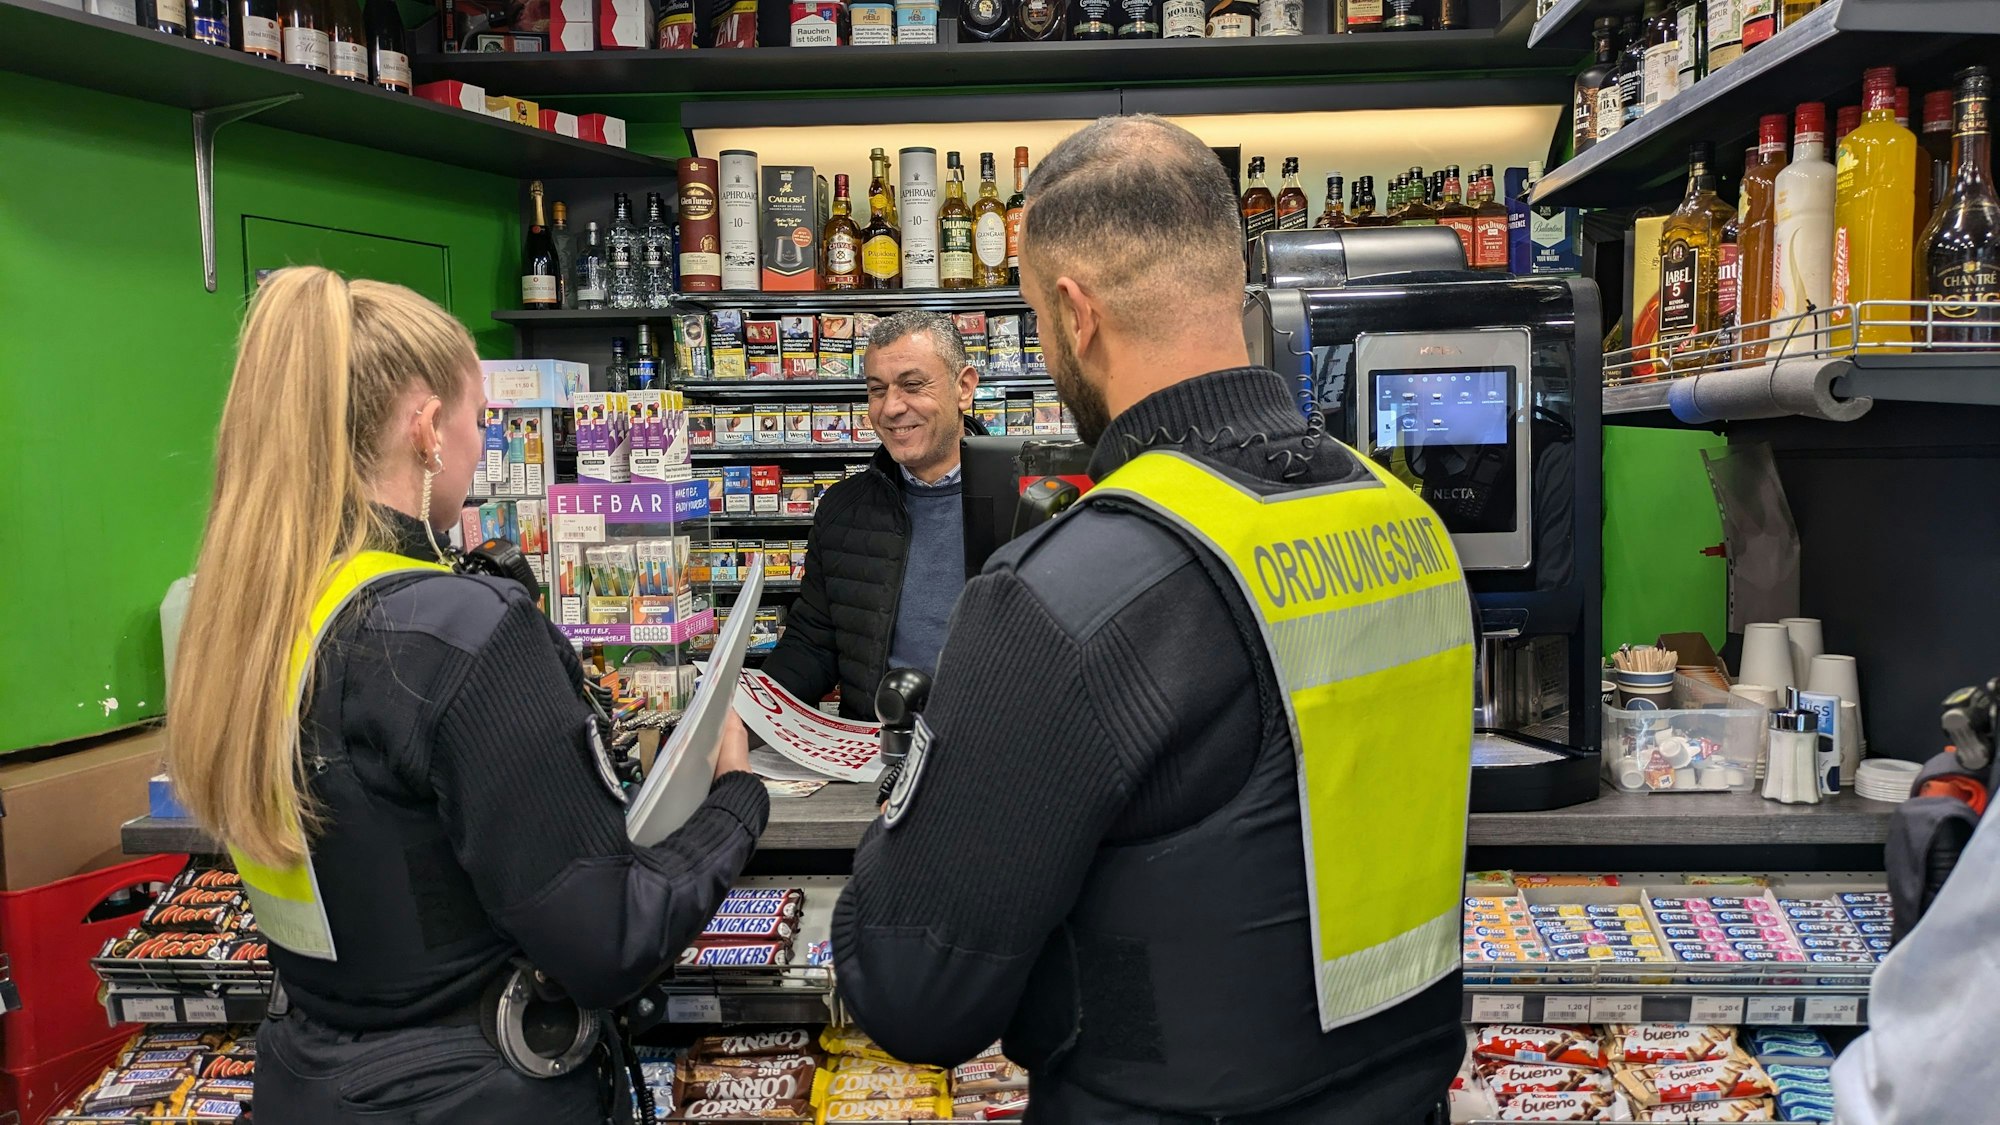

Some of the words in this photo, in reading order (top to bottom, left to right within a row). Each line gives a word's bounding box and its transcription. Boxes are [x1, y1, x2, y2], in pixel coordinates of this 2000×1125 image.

[797, 28, 830, 36] Rauchen
[806, 34, 832, 43] tödlich
[734, 217, 743, 228] 10
[912, 215, 922, 226] 10
[1477, 221, 1490, 234] JACK
[951, 229, 967, 237] DEW
[1665, 267, 1692, 287] LABEL
[1832, 226, 1848, 319] Berentzen
[1943, 270, 1997, 288] CHANTRÉ
[1671, 282, 1681, 297] 5
[1929, 292, 2000, 318] ROUG
[693, 431, 713, 445] ducal
[1433, 487, 1475, 500] NECTA
[557, 494, 662, 514] ELFBAR
[1253, 517, 1450, 609] ORDNUNGSAMT
[773, 730, 863, 770] Keine
[193, 869, 241, 887] Mar
[172, 887, 240, 905] Mars
[728, 889, 785, 899] NICKERS
[152, 904, 223, 925] Mars
[717, 900, 782, 914] NICKERS
[705, 917, 776, 933] SNICKERS
[1607, 933, 1628, 942] xtra
[126, 938, 216, 960] Mars
[231, 942, 268, 961] Ma
[700, 946, 772, 965] SNICKERS
[1500, 1003, 1515, 1011] 1,20
[1567, 1003, 1582, 1011] 1,20
[1617, 1003, 1631, 1011] 1,20
[1718, 1004, 1734, 1012] 1,20
[1770, 1004, 1786, 1012] 1,20
[1833, 1004, 1848, 1012] 1,20
[1501, 1024, 1556, 1036] bueno
[1643, 1026, 1690, 1042] bueno
[728, 1029, 810, 1054] CORNY
[142, 1050, 191, 1062] SNICKERS
[202, 1054, 255, 1079] Mar
[955, 1062, 996, 1077] hanuta
[1509, 1067, 1563, 1081] bueno
[1669, 1065, 1714, 1081] bueno
[126, 1068, 172, 1081] SNICKERS
[962, 1071, 991, 1082] RIEGEL
[717, 1074, 798, 1100] CORNY
[828, 1072, 903, 1096] CORNY
[202, 1100, 241, 1115] SNICKER
[684, 1099, 768, 1119] CORNY
[825, 1097, 903, 1121] CORNY
[1522, 1098, 1577, 1114] bueno
[1671, 1100, 1719, 1116] bueno
